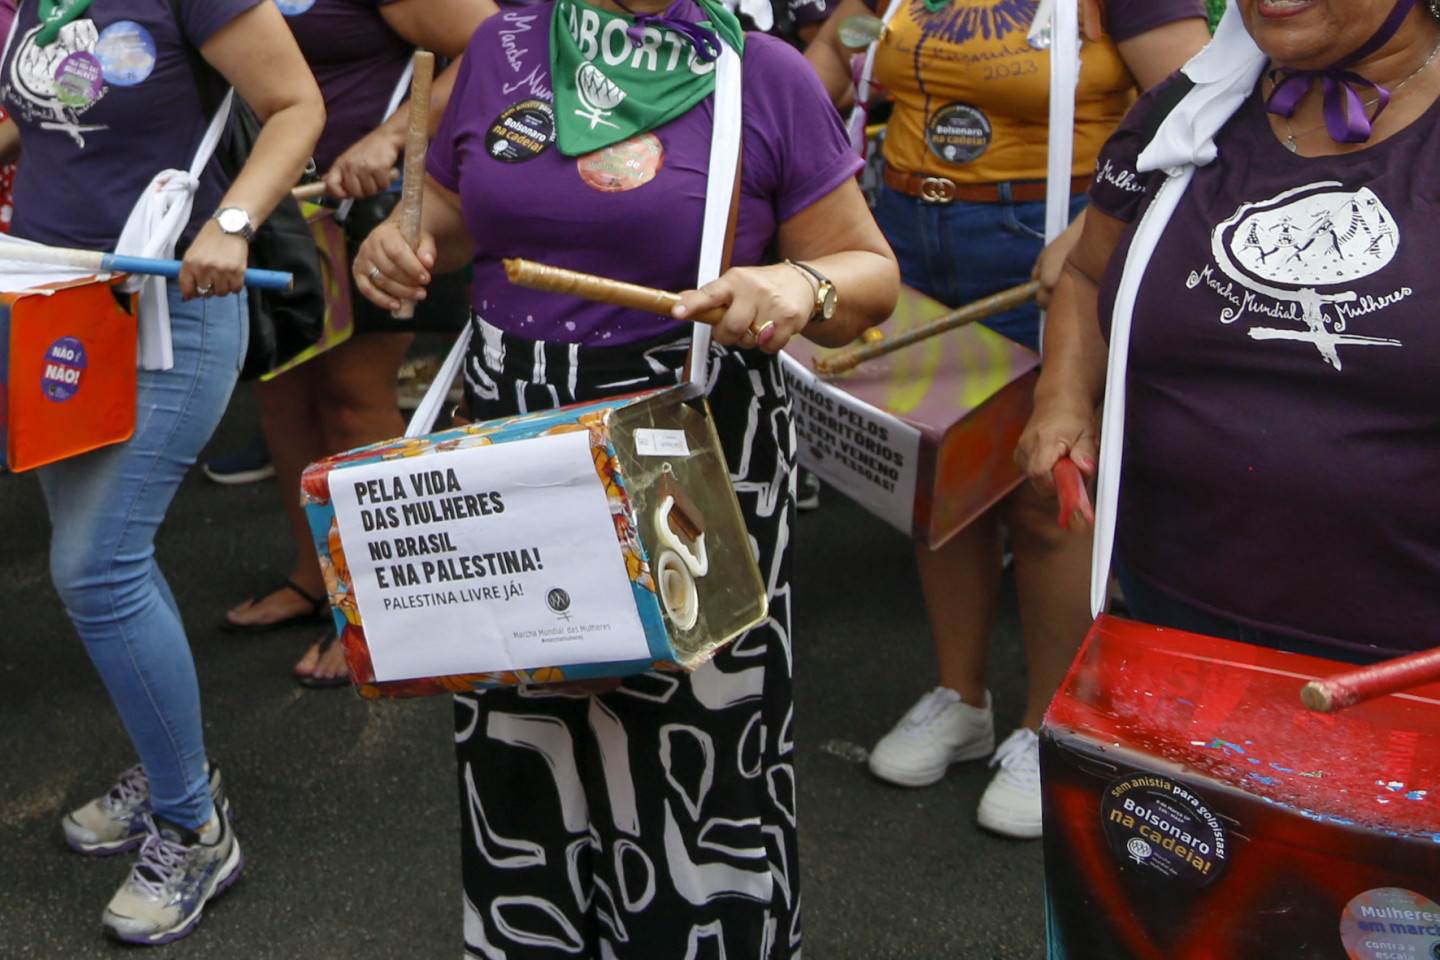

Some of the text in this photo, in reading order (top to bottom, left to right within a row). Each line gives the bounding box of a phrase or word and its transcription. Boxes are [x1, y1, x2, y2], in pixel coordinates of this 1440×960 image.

[504, 117, 546, 142] Bolsonaro
[1186, 263, 1241, 304] Marcha
[1220, 290, 1300, 323] Mundial
[1335, 287, 1412, 332] Mulheres
[52, 345, 75, 361] NÃO
[45, 363, 81, 385] NÃO!
[838, 405, 889, 441] PELOS
[840, 440, 898, 481] VENENO
[354, 468, 462, 505] PELA VIDA
[360, 491, 505, 532] DAS MULHERES
[368, 532, 458, 561] NO BRASIL
[375, 547, 544, 589] E NA PALESTINA!
[383, 580, 525, 611] PALESTINA LIVRE JÁ!
[1111, 781, 1131, 798] sem
[1132, 777, 1172, 791] anistia
[1172, 785, 1200, 807] para
[1196, 806, 1225, 860] golpistas!
[1123, 798, 1210, 855] Bolsonaro
[1110, 809, 1136, 829] na
[1139, 824, 1212, 875] cadeia!
[1358, 921, 1386, 933] em
[1365, 940, 1406, 951] contra
